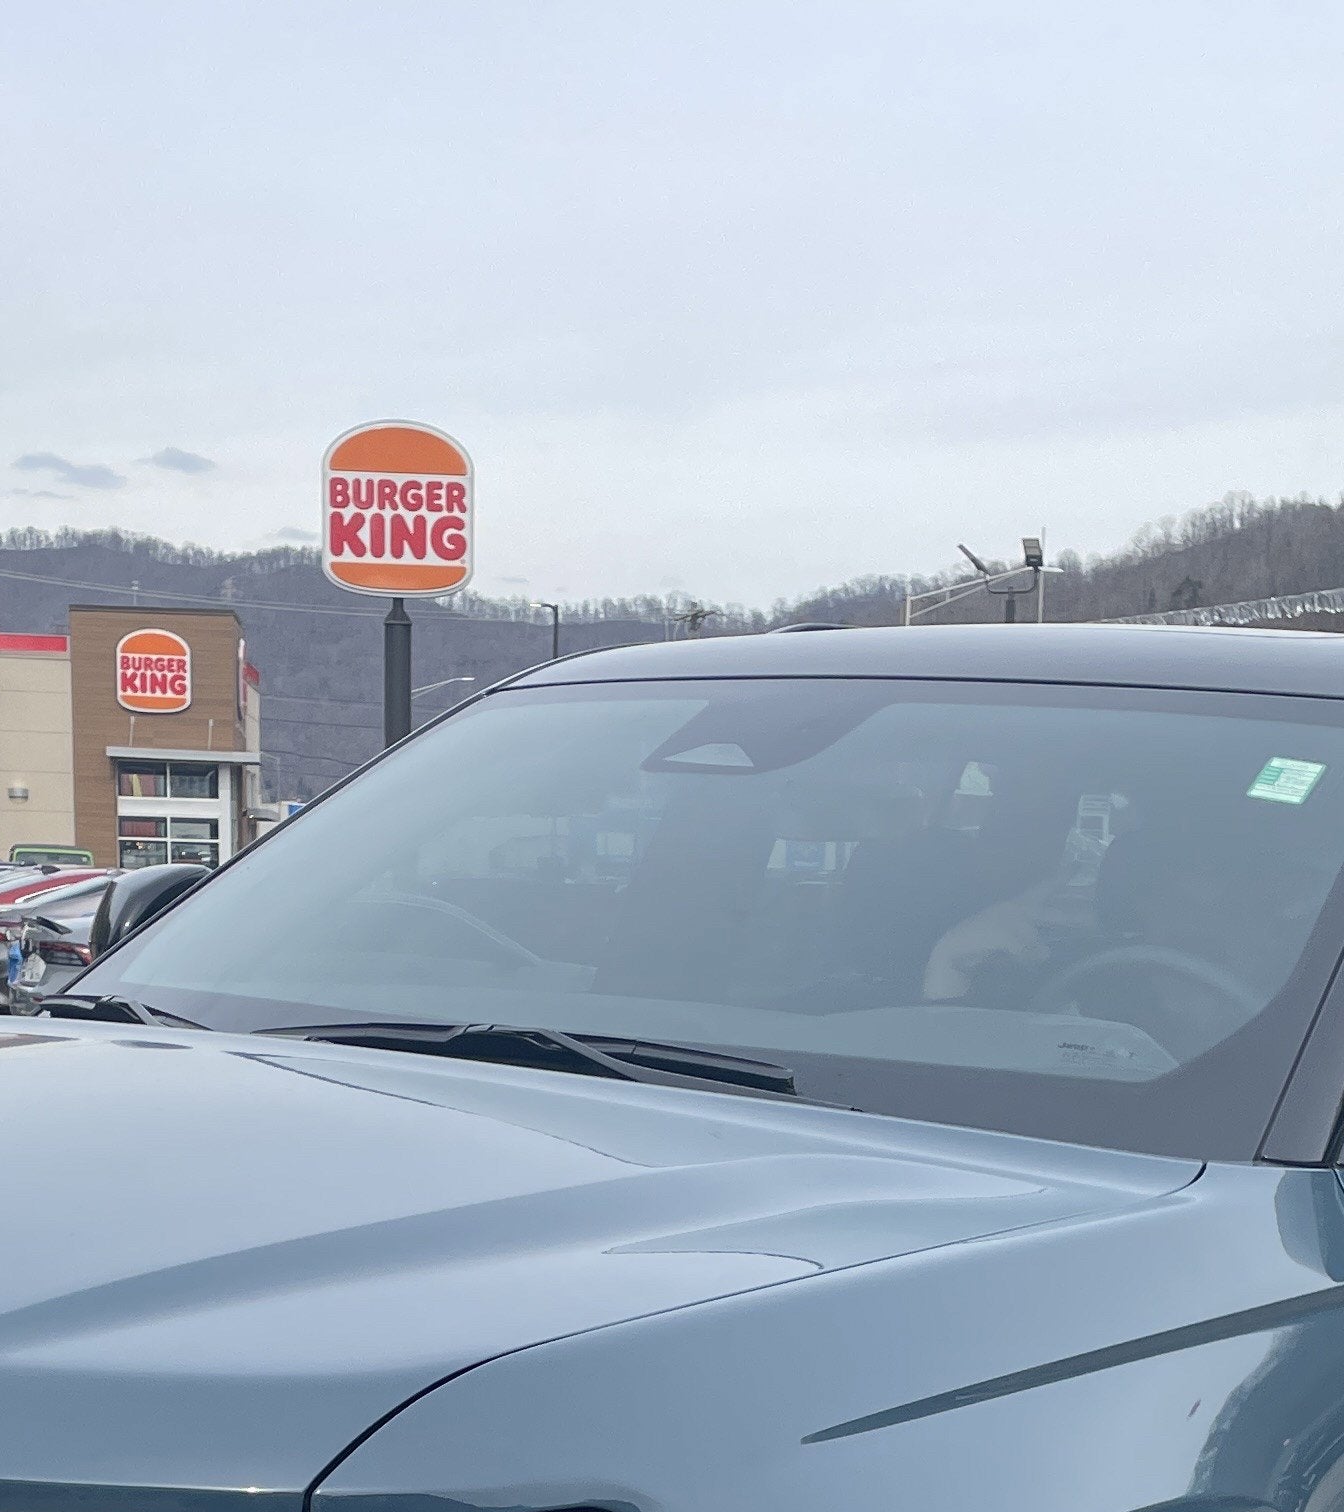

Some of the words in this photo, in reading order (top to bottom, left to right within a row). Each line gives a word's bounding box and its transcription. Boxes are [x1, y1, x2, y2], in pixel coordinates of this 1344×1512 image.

[329, 476, 467, 514] BURGER
[329, 511, 467, 561] KING
[120, 655, 187, 674] BURGER
[120, 671, 187, 696] KING
